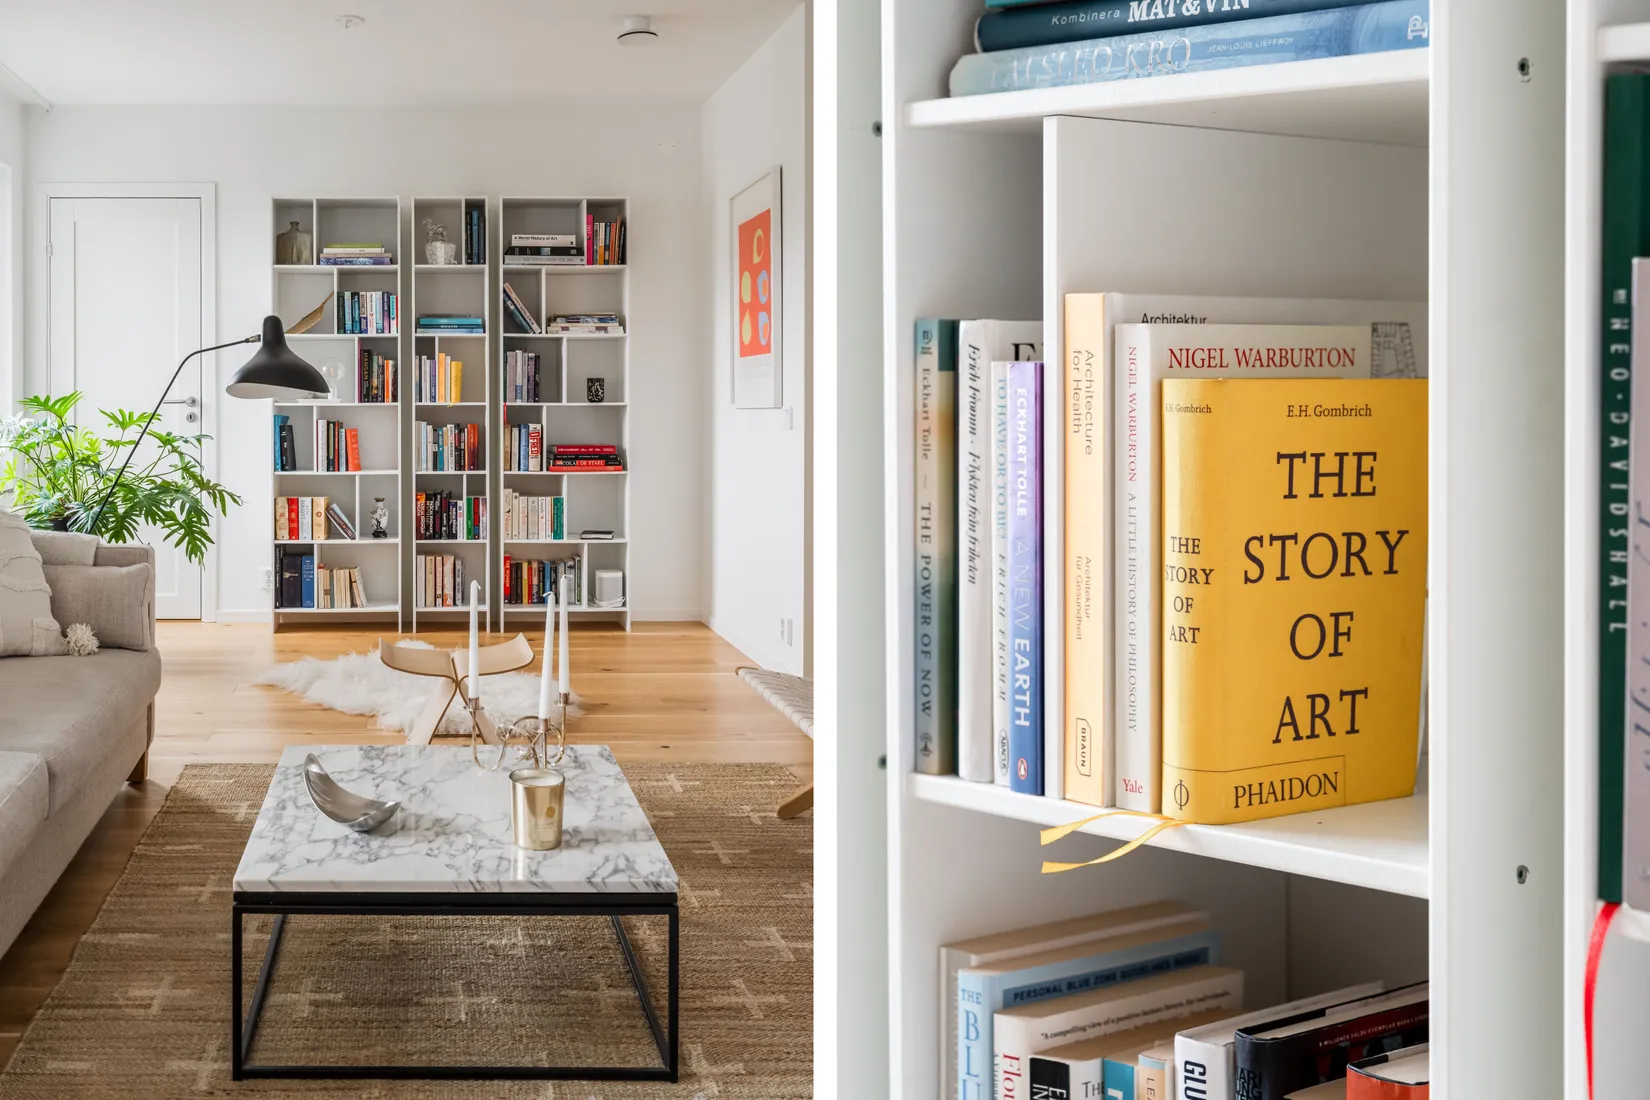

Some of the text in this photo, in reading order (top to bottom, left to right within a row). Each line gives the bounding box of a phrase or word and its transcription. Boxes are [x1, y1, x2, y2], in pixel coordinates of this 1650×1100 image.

[1051, 8, 1120, 26] Kombinera
[1125, 37, 1191, 74] KRO
[1207, 37, 1294, 53] JEAN-LOUIS LIEFFROY
[1141, 313, 1207, 325] Architektur
[1168, 347, 1356, 368] NIGEL WARBURTON
[998, 379, 1007, 399] TO
[1073, 350, 1082, 434] for Health
[1085, 349, 1094, 455] Architecture
[1175, 403, 1212, 414] Gombrich
[1287, 403, 1372, 418] E.H. Gombrich
[998, 405, 1007, 449] HAVE
[966, 344, 980, 585] Erich Fromm Flykten från friheten
[998, 454, 1007, 477] OR
[1276, 450, 1378, 500] THE
[997, 483, 1007, 506] TO
[997, 511, 1007, 539] BE?
[921, 368, 931, 717] Eckhart Tolle THE POWER OF NOW
[1128, 346, 1137, 732] NIGEL WARBURTON A LITTLE HISTORY OF PHILOSOPHY
[1170, 536, 1201, 555] THE
[1014, 388, 1031, 727] ECKHART TOLLE A NEW EARTH
[1244, 530, 1409, 585] STORY
[1165, 564, 1214, 585] STORY
[1173, 596, 1194, 613] OF
[1169, 624, 1200, 644] ART
[1289, 611, 1354, 660] OF
[1272, 686, 1368, 744] ART
[1123, 779, 1143, 794] Yale
[1233, 771, 1339, 808] PHAIDON
[961, 988, 982, 1005] THE
[1013, 980, 1063, 1002] PERSONAL
[1066, 975, 1092, 991] BLUE
[1093, 970, 1118, 987] ZONE
[1049, 1023, 1086, 1041] compelling
[1087, 1020, 1102, 1030] view
[1102, 1018, 1111, 1028] of
[1115, 1012, 1141, 1026] positive
[1323, 1035, 1350, 1046] MILJONER
[1146, 1077, 1156, 1100] LE
